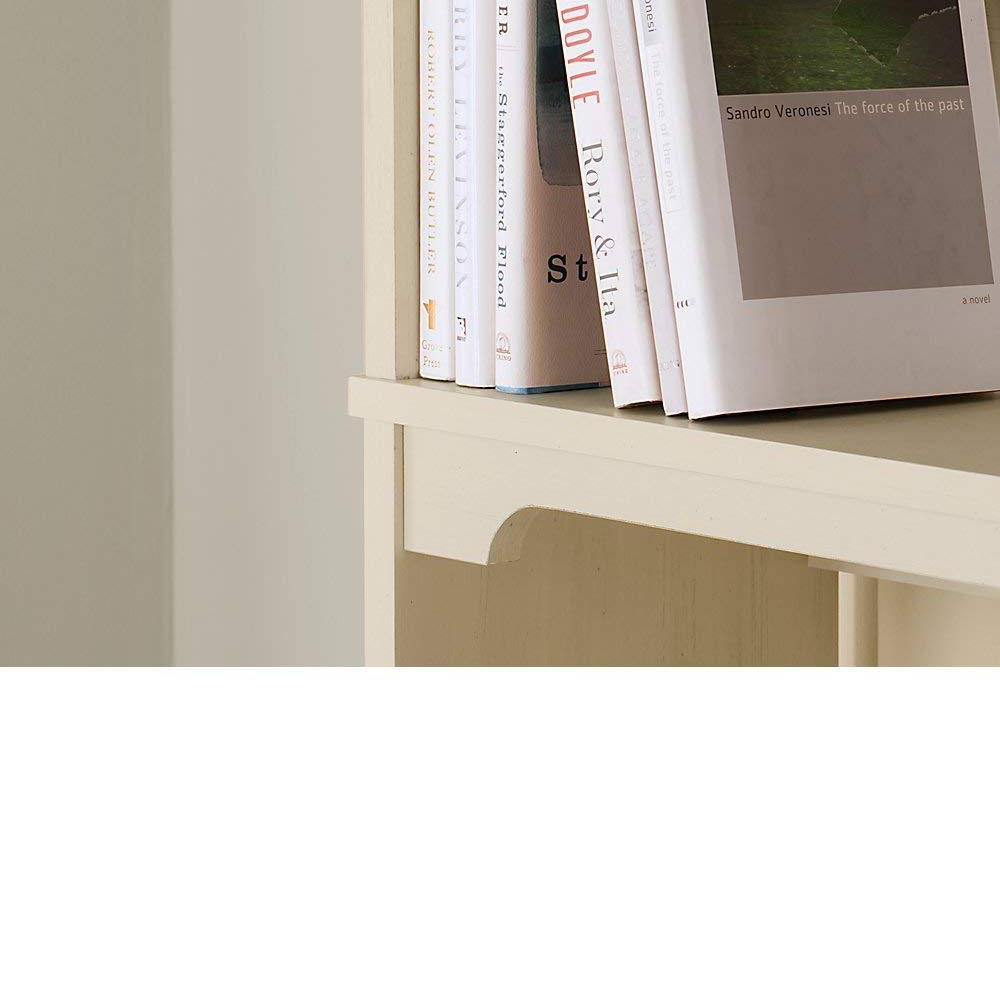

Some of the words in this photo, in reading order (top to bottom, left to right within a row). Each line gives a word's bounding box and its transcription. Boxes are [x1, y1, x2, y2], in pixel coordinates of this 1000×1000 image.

[427, 30, 436, 116] ROBERT
[560, 3, 601, 109] DOYLE
[726, 105, 771, 120] Sandro
[775, 103, 832, 118] Veronesi
[835, 101, 858, 115] The
[862, 100, 893, 115] force
[898, 98, 912, 113] of
[914, 98, 935, 113] the
[939, 97, 965, 115] past
[427, 123, 436, 181] OLEN
[496, 93, 508, 232] Staggerford
[581, 138, 605, 224] Rory
[454, 98, 468, 289] LEVINSON
[664, 170, 678, 200] past
[427, 191, 437, 274] BUTLER
[594, 234, 616, 260] &
[497, 245, 507, 308] Flood
[599, 268, 619, 320] Ita
[962, 297, 968, 305] a
[969, 294, 991, 305] novel
